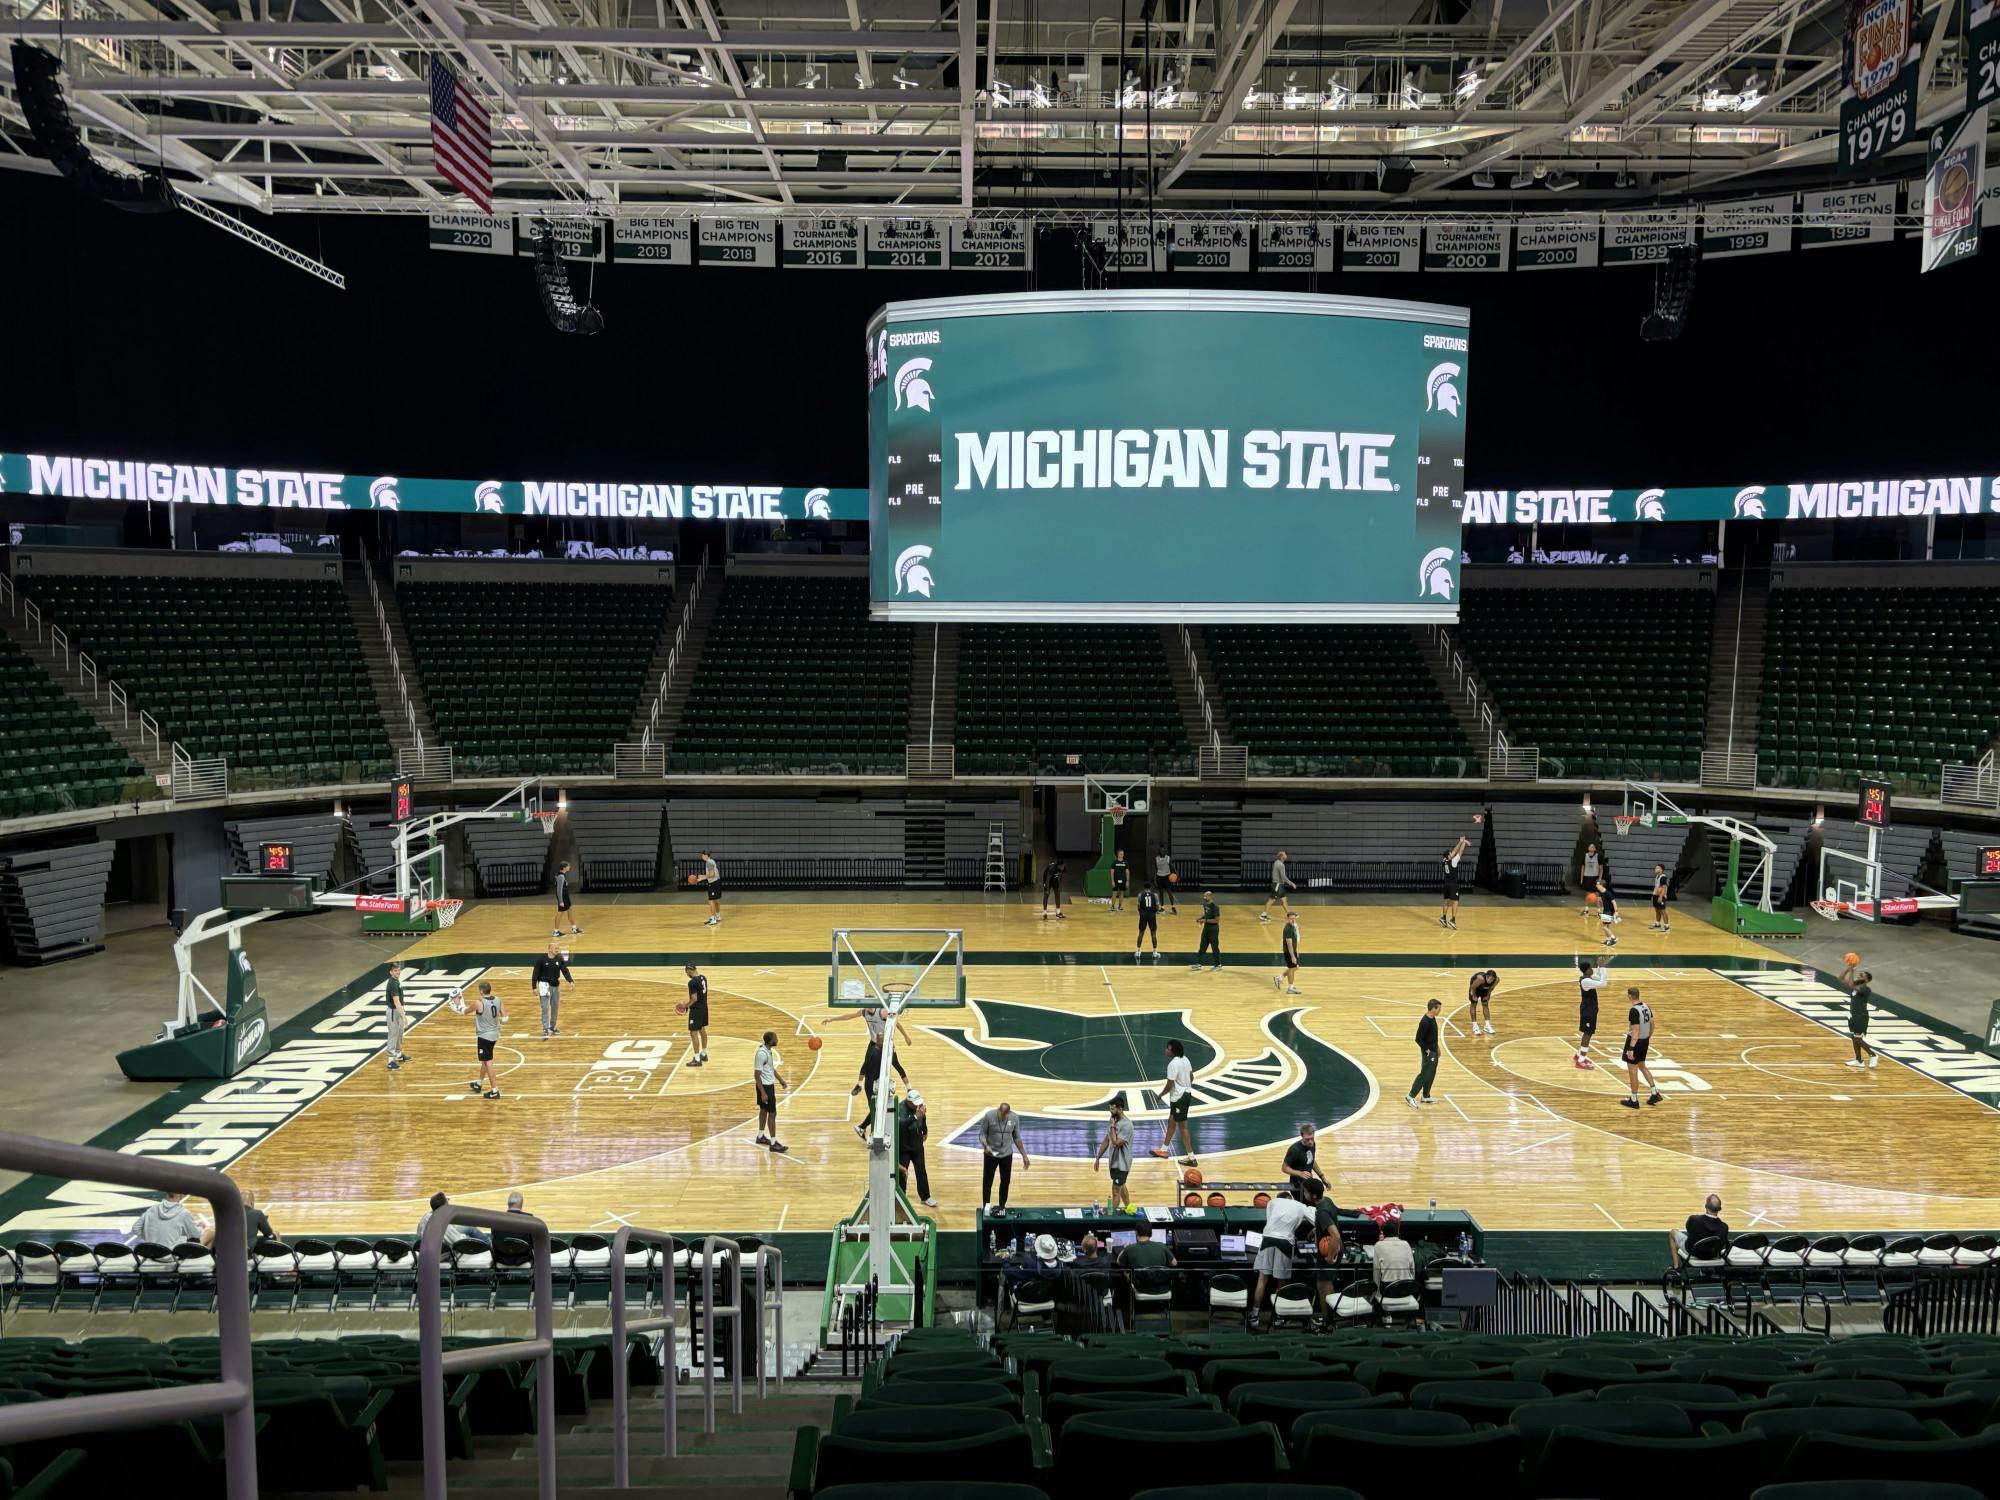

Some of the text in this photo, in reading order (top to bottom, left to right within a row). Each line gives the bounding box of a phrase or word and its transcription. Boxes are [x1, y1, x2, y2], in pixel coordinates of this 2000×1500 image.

[1860, 7, 1904, 47] FINAL
[1863, 61, 1893, 88] 1979
[1847, 89, 1908, 134] CHAMPIONS
[1848, 108, 1906, 166] 1979
[1823, 192, 1877, 208] BIG TEN
[1749, 204, 1774, 215] TEN
[1952, 206, 1970, 223] FOUR
[432, 215, 511, 231] CHAMPIONS
[630, 219, 675, 229] BIG TEN
[715, 220, 760, 230] BIG TEN
[616, 228, 689, 241] CHAMPIONS
[1129, 225, 1150, 235] TEN
[1212, 226, 1233, 235] TEN
[1360, 226, 1404, 235] BIG TEN
[1830, 226, 1866, 240] 1998
[453, 231, 490, 247] 2020
[702, 232, 774, 243] CHAMPIONS
[1178, 239, 1248, 248] CHAMPIONS
[1261, 239, 1332, 248] CHAMPIONS
[1346, 238, 1418, 248] CHAMPIONS
[1437, 233, 1501, 241] TOURNAMENT
[1520, 232, 1596, 245] CHAMPIONS
[1615, 231, 1686, 244] CHAMPIONS
[1730, 234, 1764, 249] 1999
[793, 240, 857, 248] CHAMPIONS
[878, 241, 941, 249] CHAMPIONS
[961, 242, 1025, 250] CHAMPIONS
[1435, 243, 1501, 251] CHAMPIONS
[1954, 236, 1978, 257] 1957
[637, 246, 668, 258] 2019
[722, 248, 753, 260] 2018
[806, 251, 842, 265] 2016
[890, 252, 927, 265] 2014
[1537, 250, 1575, 263] 2000
[1631, 244, 1669, 260] 1999
[975, 253, 1010, 266] 2012
[1197, 254, 1228, 265] 2010
[1278, 254, 1312, 265] 2009
[1366, 254, 1397, 265] 2001
[1446, 254, 1488, 268] 2000
[889, 331, 940, 347] SPARTANS
[1423, 335, 1467, 351] SPARTANS
[954, 429, 1396, 491] MICHIGAN STATE
[1418, 456, 1430, 465] FLS
[27, 454, 345, 510] MICHIGAN STATE
[905, 483, 924, 495] PRE
[1432, 486, 1449, 497] PRE
[521, 480, 785, 520] MICHIGAN STATE
[1416, 498, 1428, 507] FLS
[1786, 475, 1981, 520] MICHIGAN
[1515, 489, 1614, 523] STATE
[1866, 799, 1883, 822] 24
[268, 847, 289, 856] 4:51
[269, 856, 285, 869] 24
[1985, 860, 2000, 872] 24
[1145, 895, 1152, 908] 11
[491, 1005, 497, 1018] 0
[1642, 1008, 1650, 1024] 15
[0, 1038, 390, 1235] MCHIGAN
